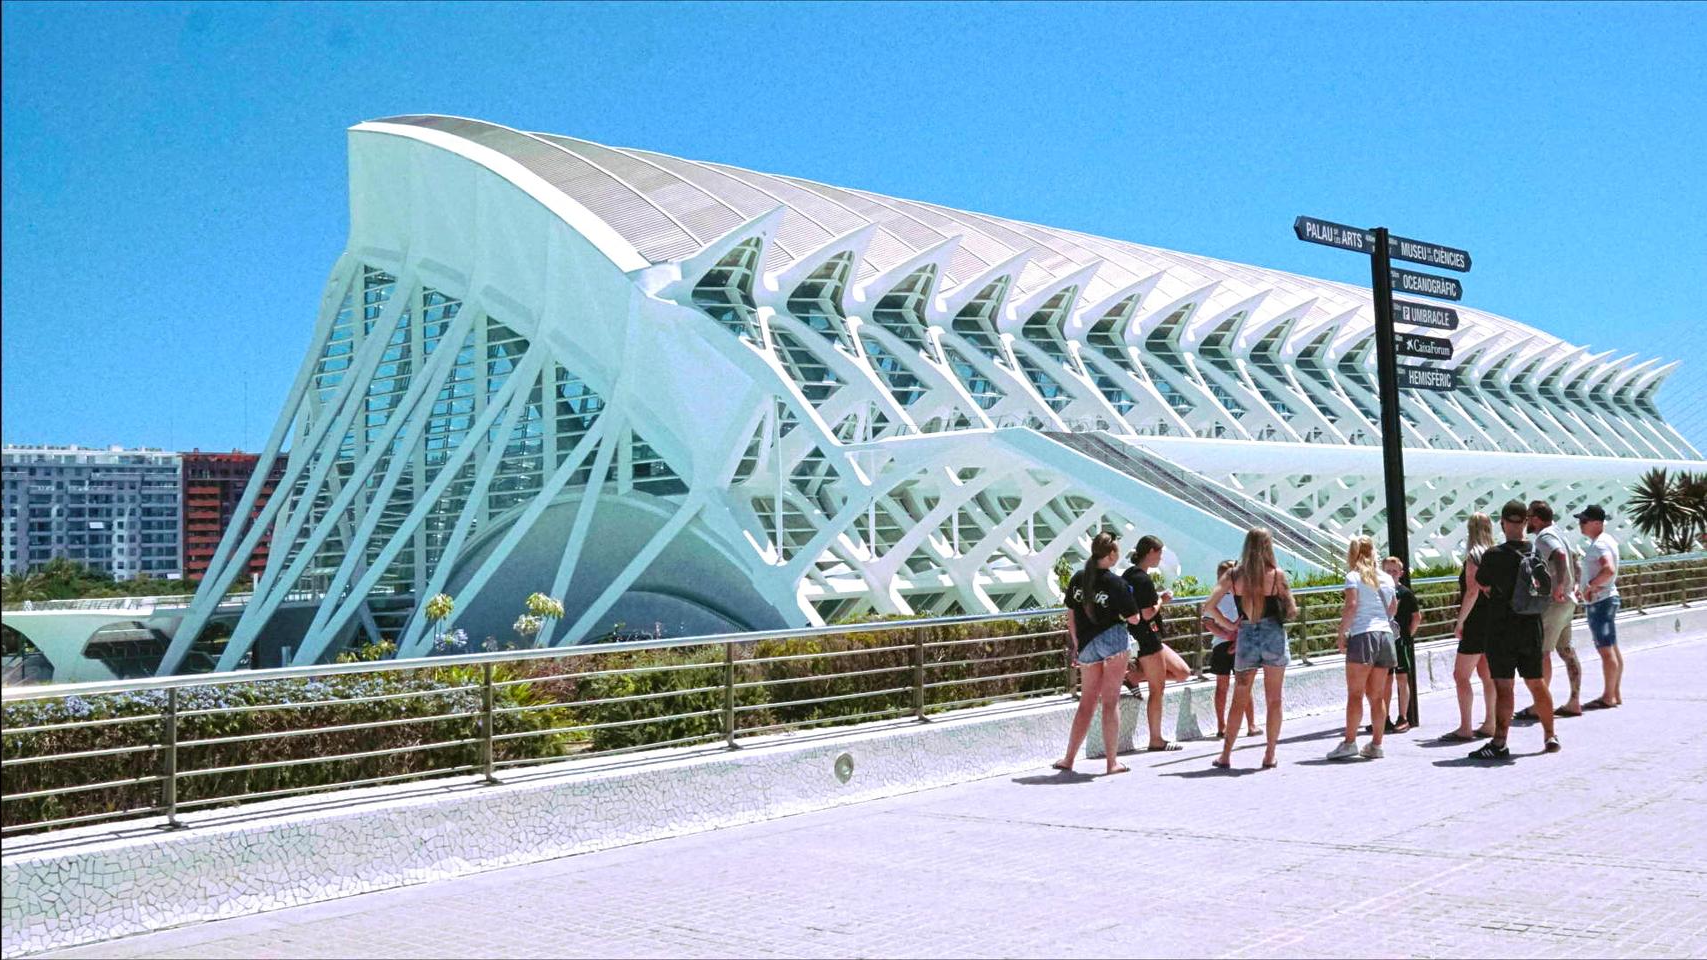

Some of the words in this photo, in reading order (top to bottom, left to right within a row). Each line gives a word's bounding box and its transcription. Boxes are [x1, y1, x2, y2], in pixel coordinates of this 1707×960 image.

[1306, 221, 1333, 242] PALAU
[1341, 230, 1363, 248] ARTS
[1400, 241, 1427, 260] MUSEU
[1411, 308, 1450, 326] UMBRACLE
[1414, 339, 1450, 355] CaixaForum
